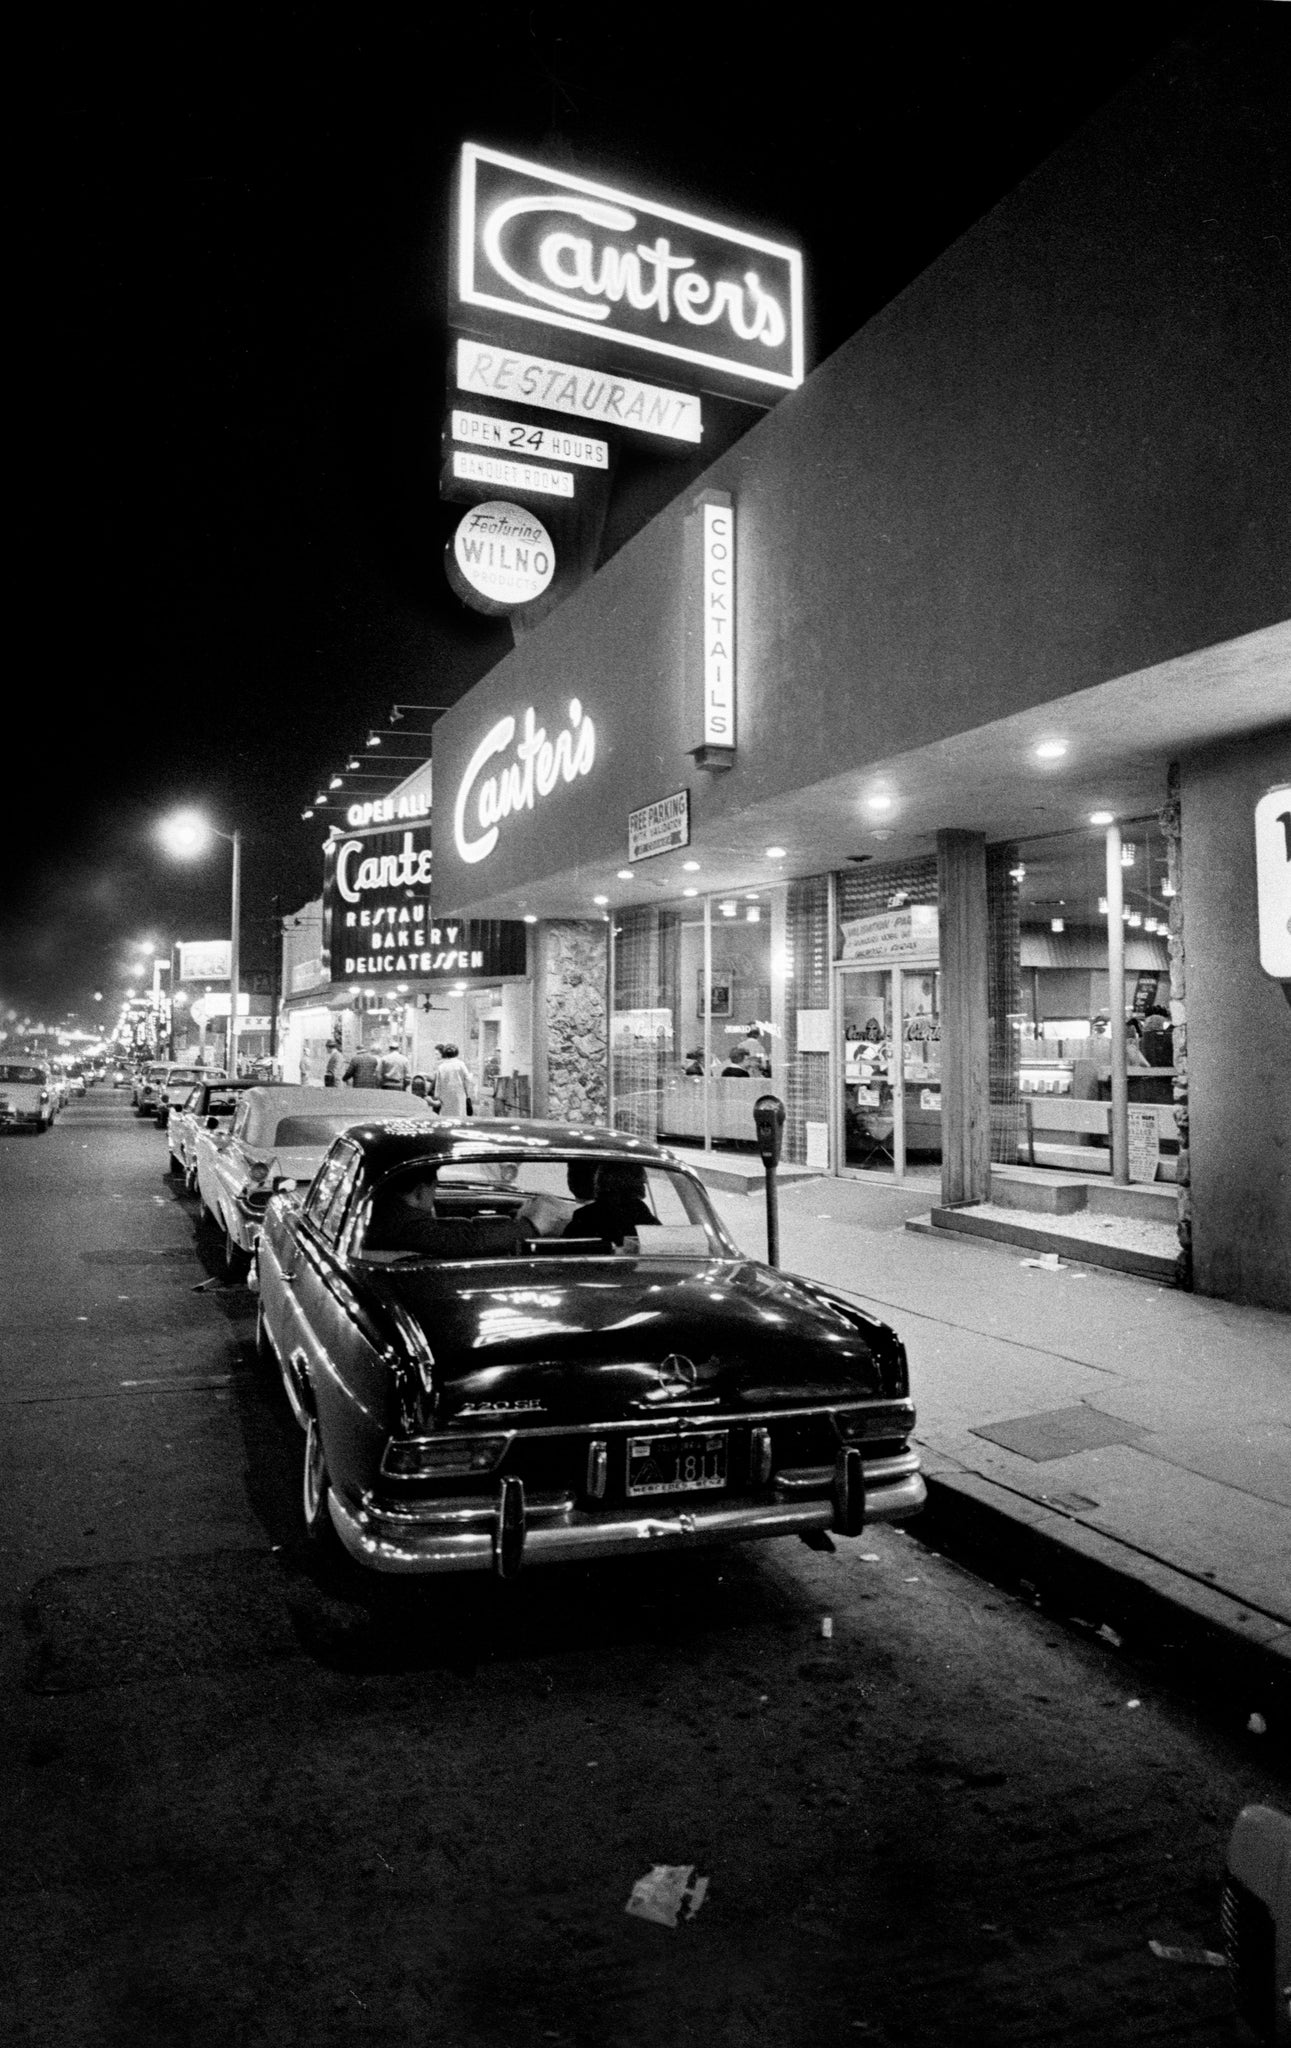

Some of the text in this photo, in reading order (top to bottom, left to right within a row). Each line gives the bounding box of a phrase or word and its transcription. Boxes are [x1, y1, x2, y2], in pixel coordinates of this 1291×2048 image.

[483, 195, 785, 347] Canter's
[468, 353, 692, 431] RESTAURANT
[460, 418, 604, 463] OPEN 24 HOURS
[461, 457, 569, 492] BANQUET ROOMS
[469, 514, 542, 543] Featuring
[462, 537, 548, 575] WILNO
[711, 518, 728, 734] COCKTAILS
[455, 698, 595, 863] Canter's
[348, 794, 430, 826] OPEN ALL
[649, 795, 685, 826] PARKING
[372, 927, 458, 949] BAKERY
[345, 951, 484, 973] DELICATESSEN
